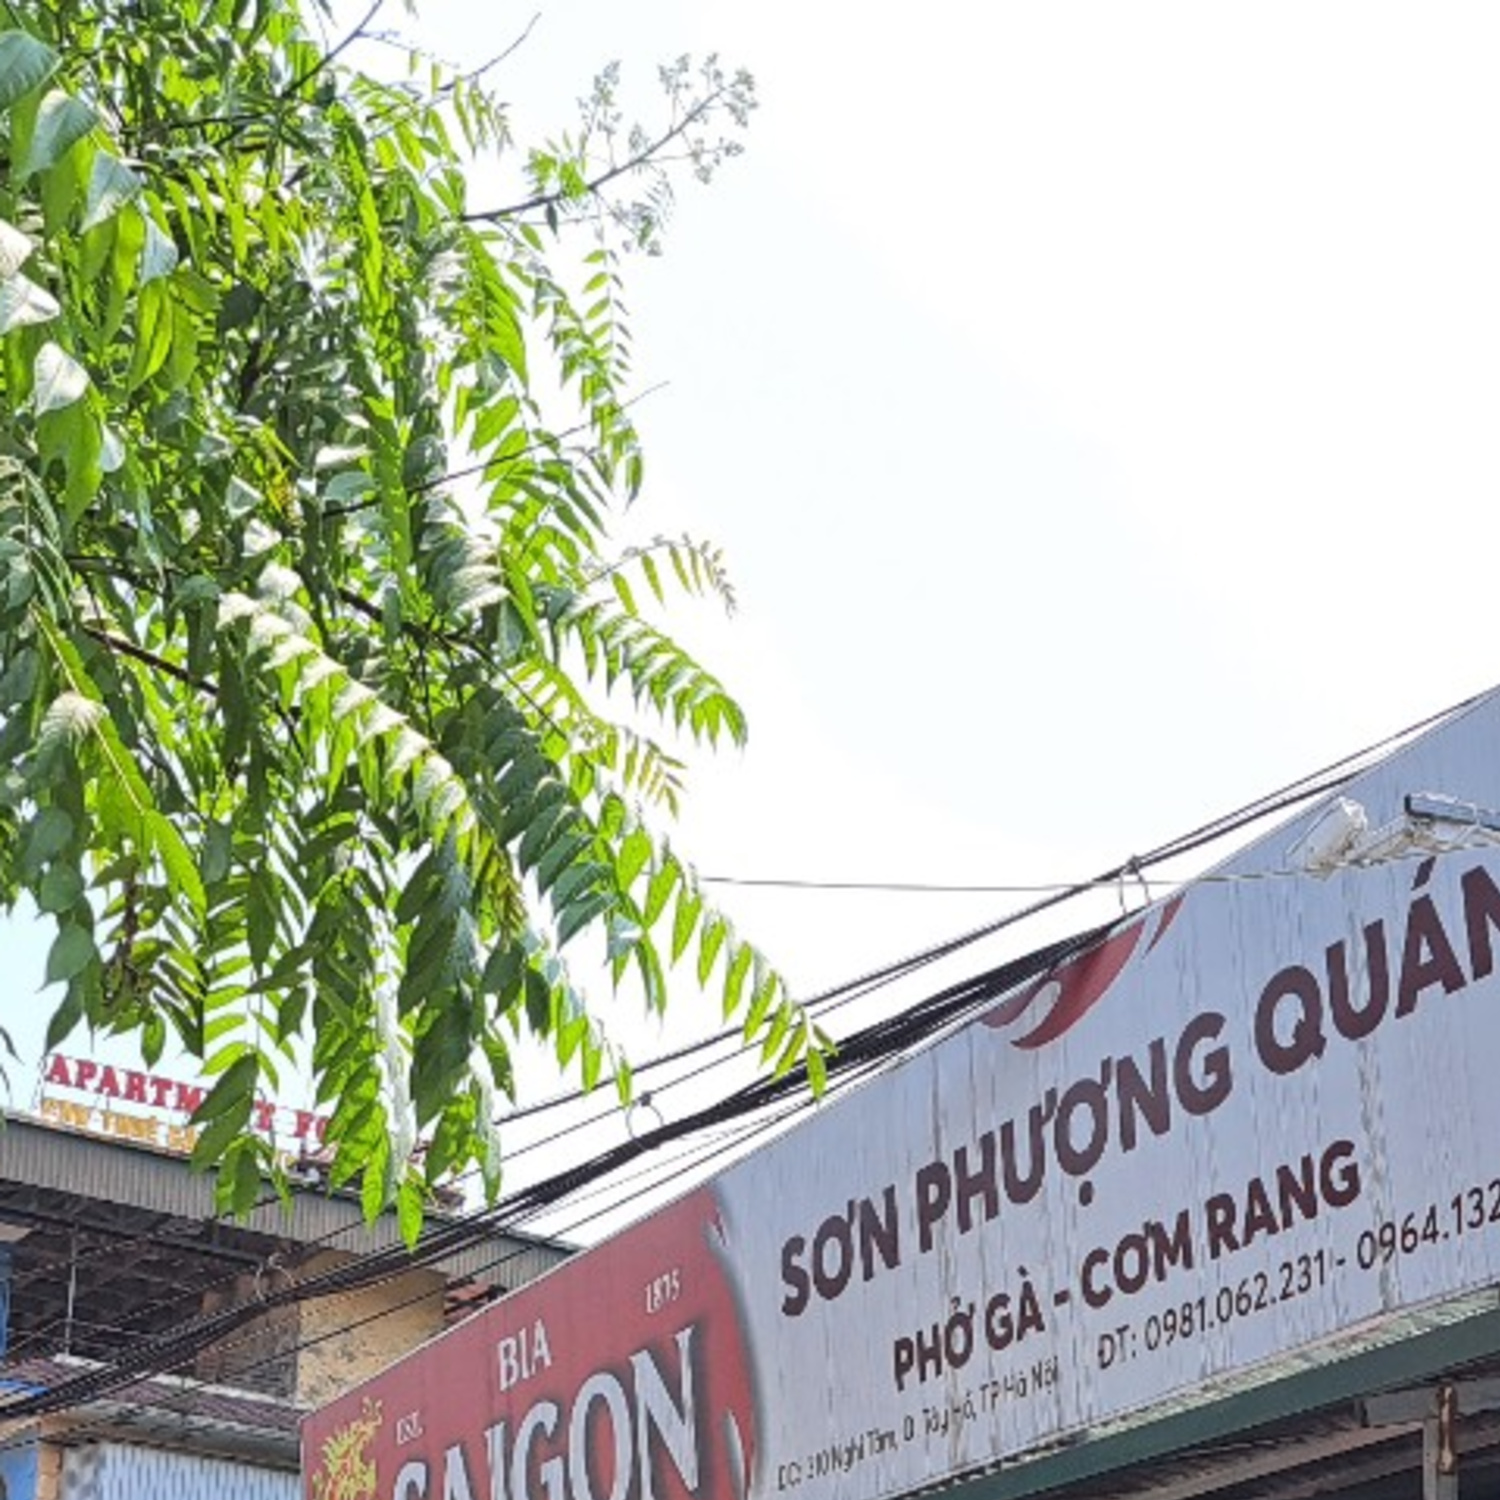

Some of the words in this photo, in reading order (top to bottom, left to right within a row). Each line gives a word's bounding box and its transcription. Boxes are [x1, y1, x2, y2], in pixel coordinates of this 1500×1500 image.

[781, 1184, 901, 1317] SƠN
[917, 1012, 1233, 1253] PHƯỢNG
[644, 1268, 680, 1314] 1875
[895, 1296, 974, 1392] PHỞ
[985, 1266, 1045, 1352] GÀ
[1081, 1208, 1193, 1309] CƠM
[1206, 1139, 1361, 1260] RANG
[498, 1318, 553, 1392] BIA
